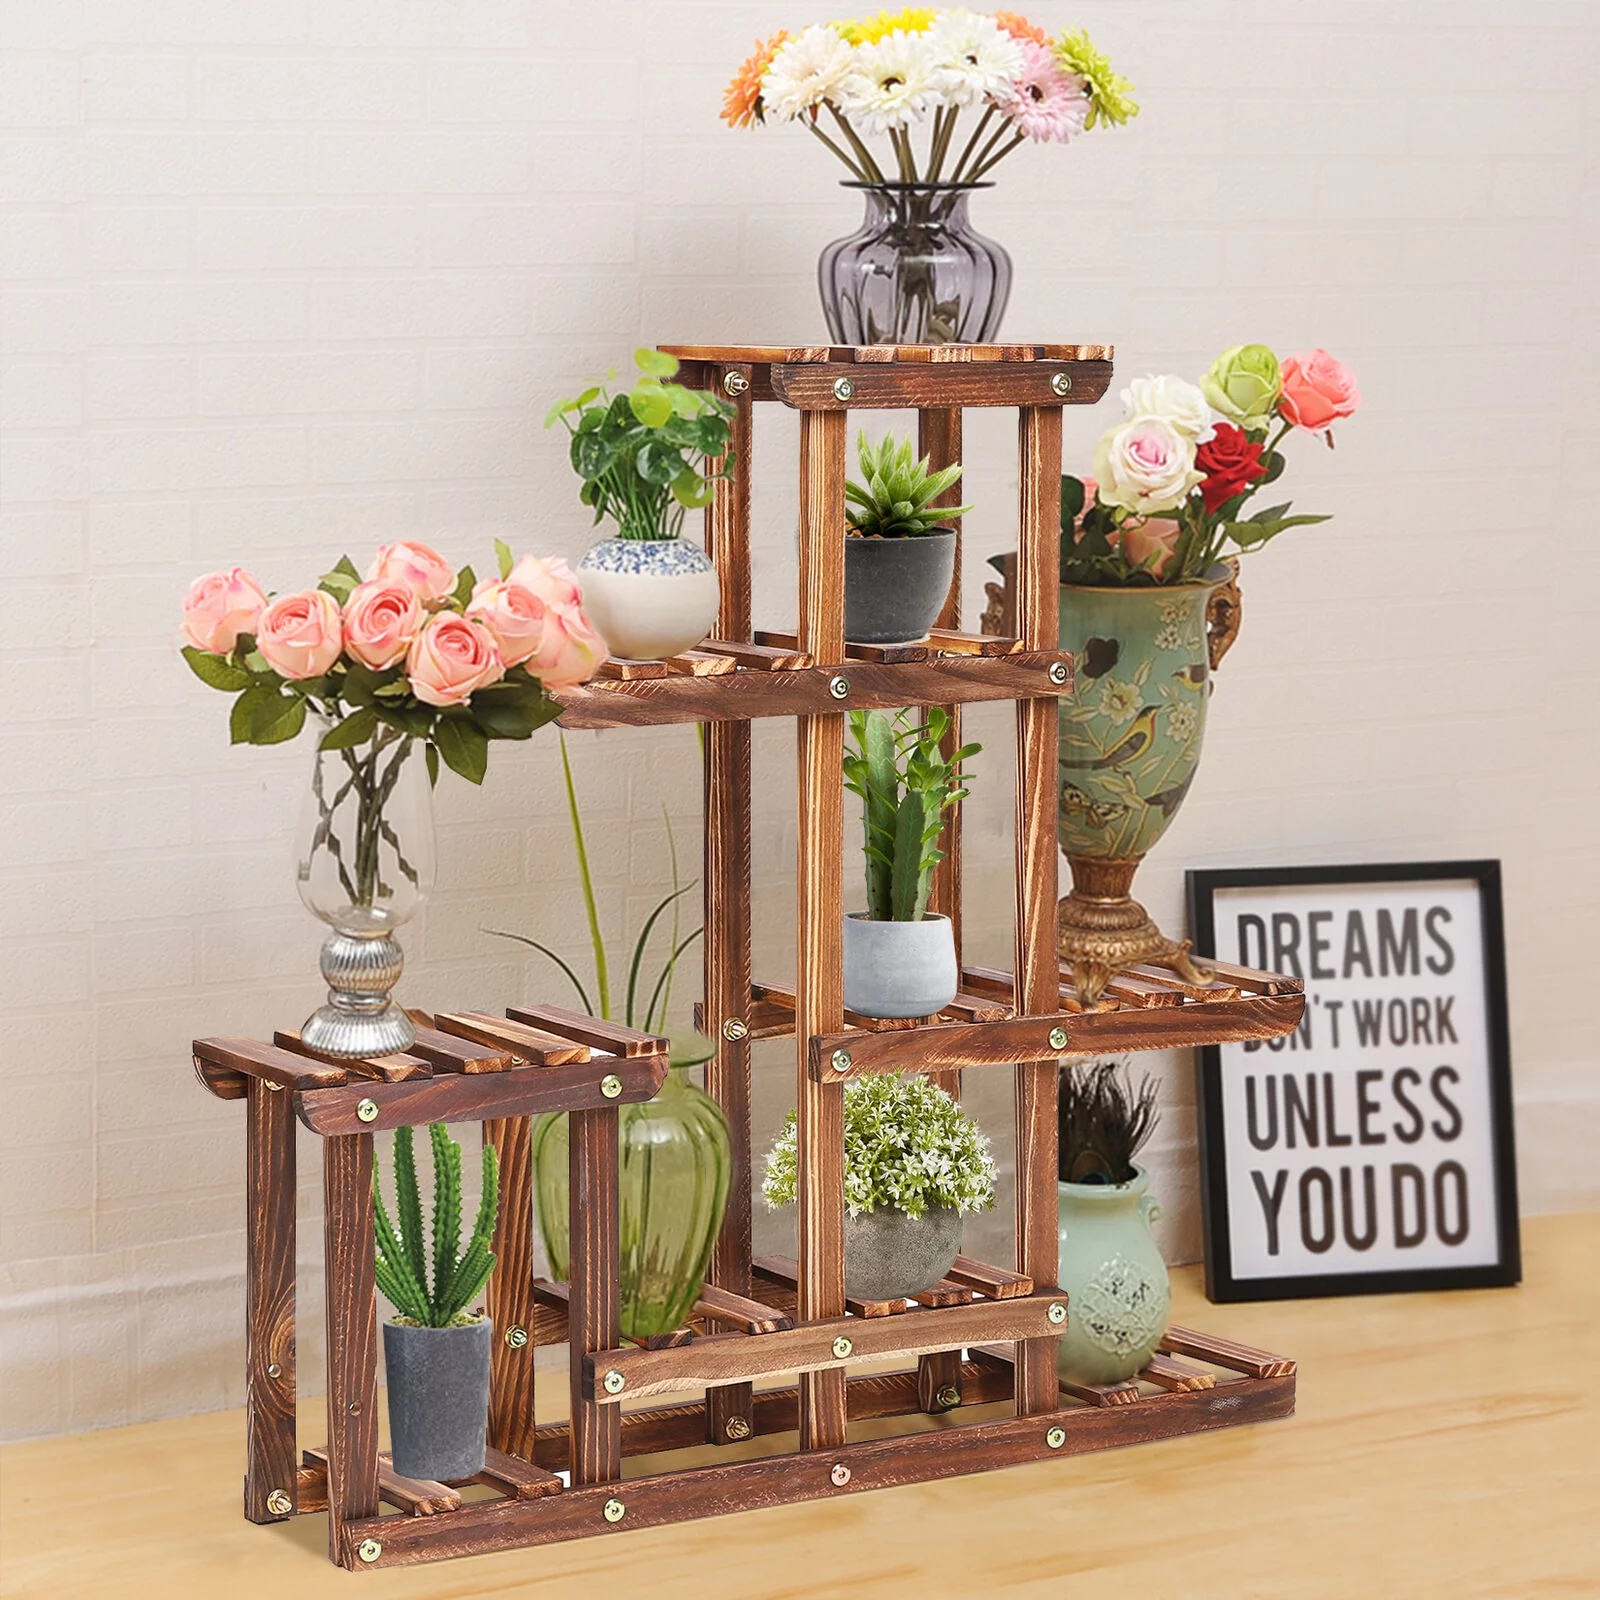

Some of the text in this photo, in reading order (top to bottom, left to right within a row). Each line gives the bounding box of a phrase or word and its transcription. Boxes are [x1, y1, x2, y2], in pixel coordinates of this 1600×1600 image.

[1237, 905, 1455, 981] DREAMS
[1243, 994, 1459, 1053] N'T WORK
[1244, 1065, 1463, 1151] UNLESS
[1250, 1159, 1470, 1256] YOU DO
